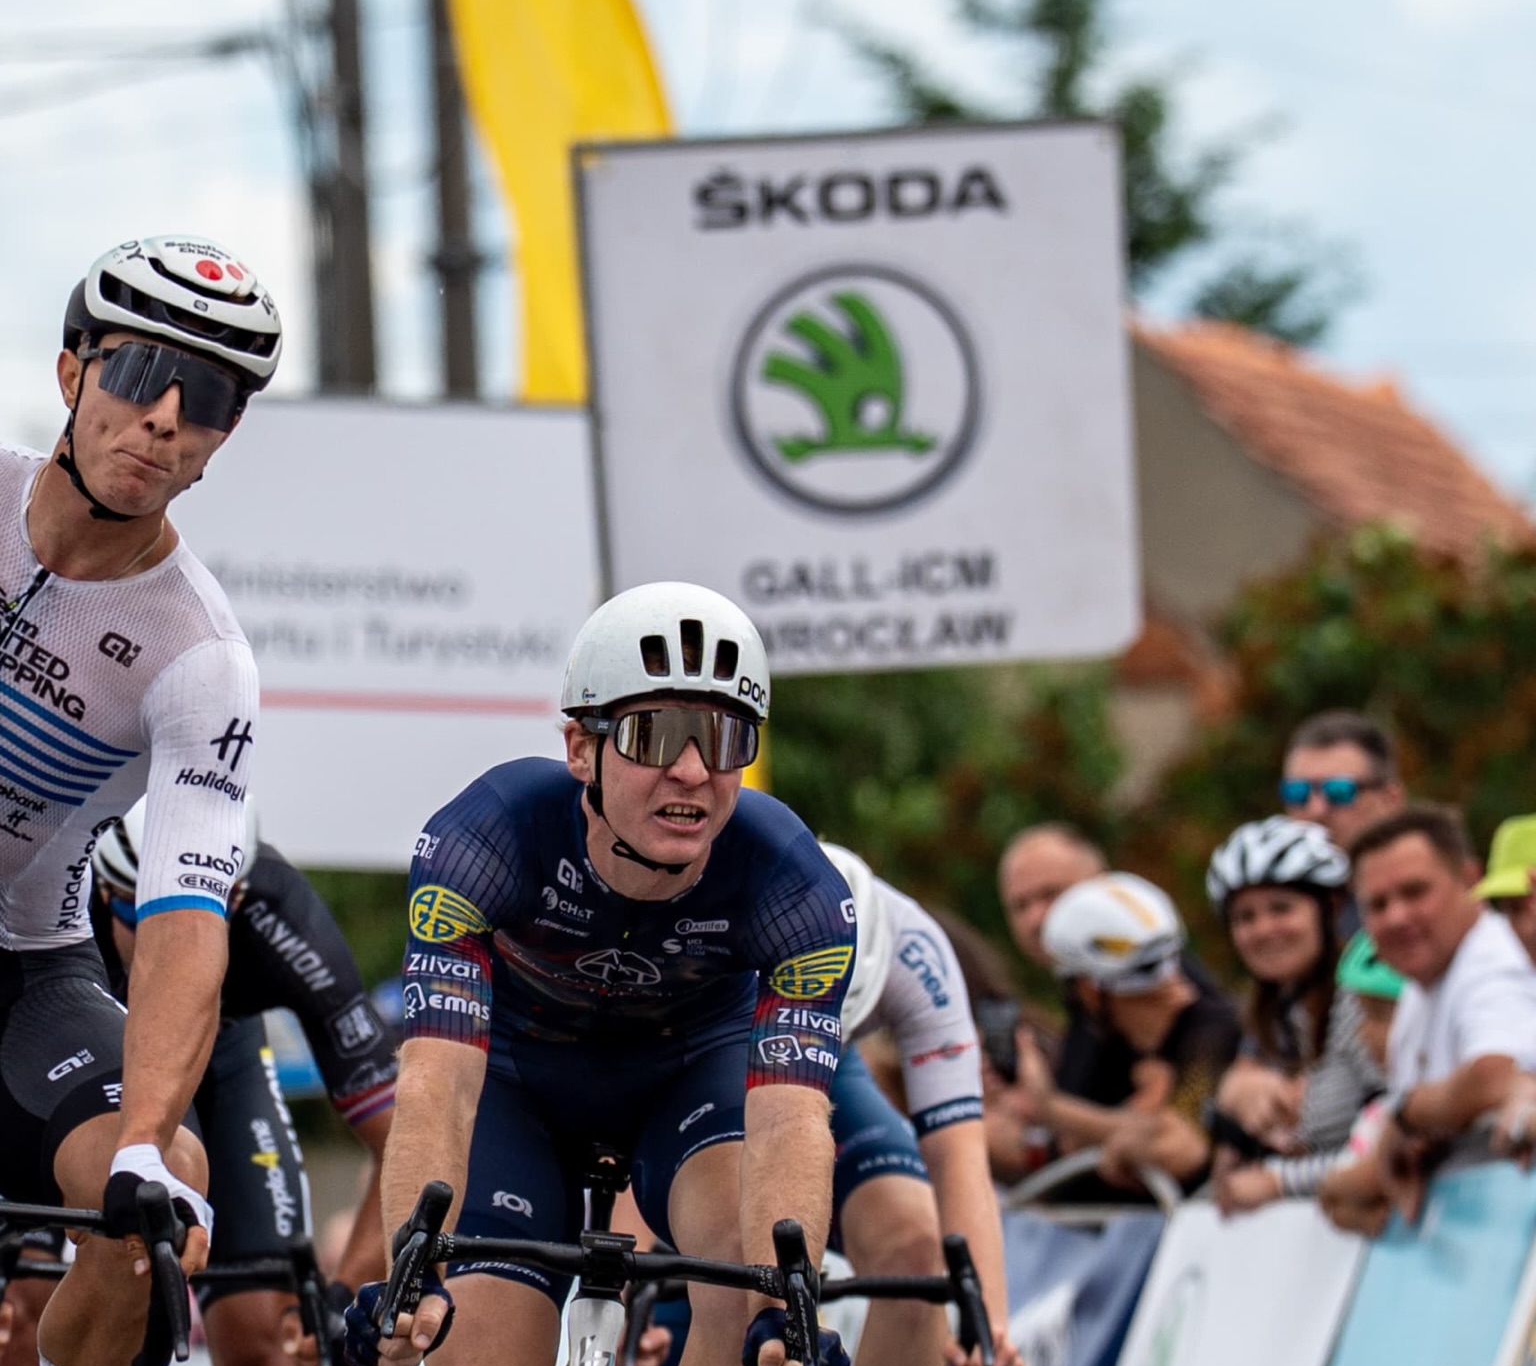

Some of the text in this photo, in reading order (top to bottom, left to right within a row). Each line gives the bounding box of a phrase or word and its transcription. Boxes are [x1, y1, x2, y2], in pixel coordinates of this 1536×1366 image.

[175, 767, 242, 802] Holiday
[244, 900, 337, 991] RAYMON
[407, 953, 481, 980] Zilvar
[898, 940, 950, 1010] Enea
